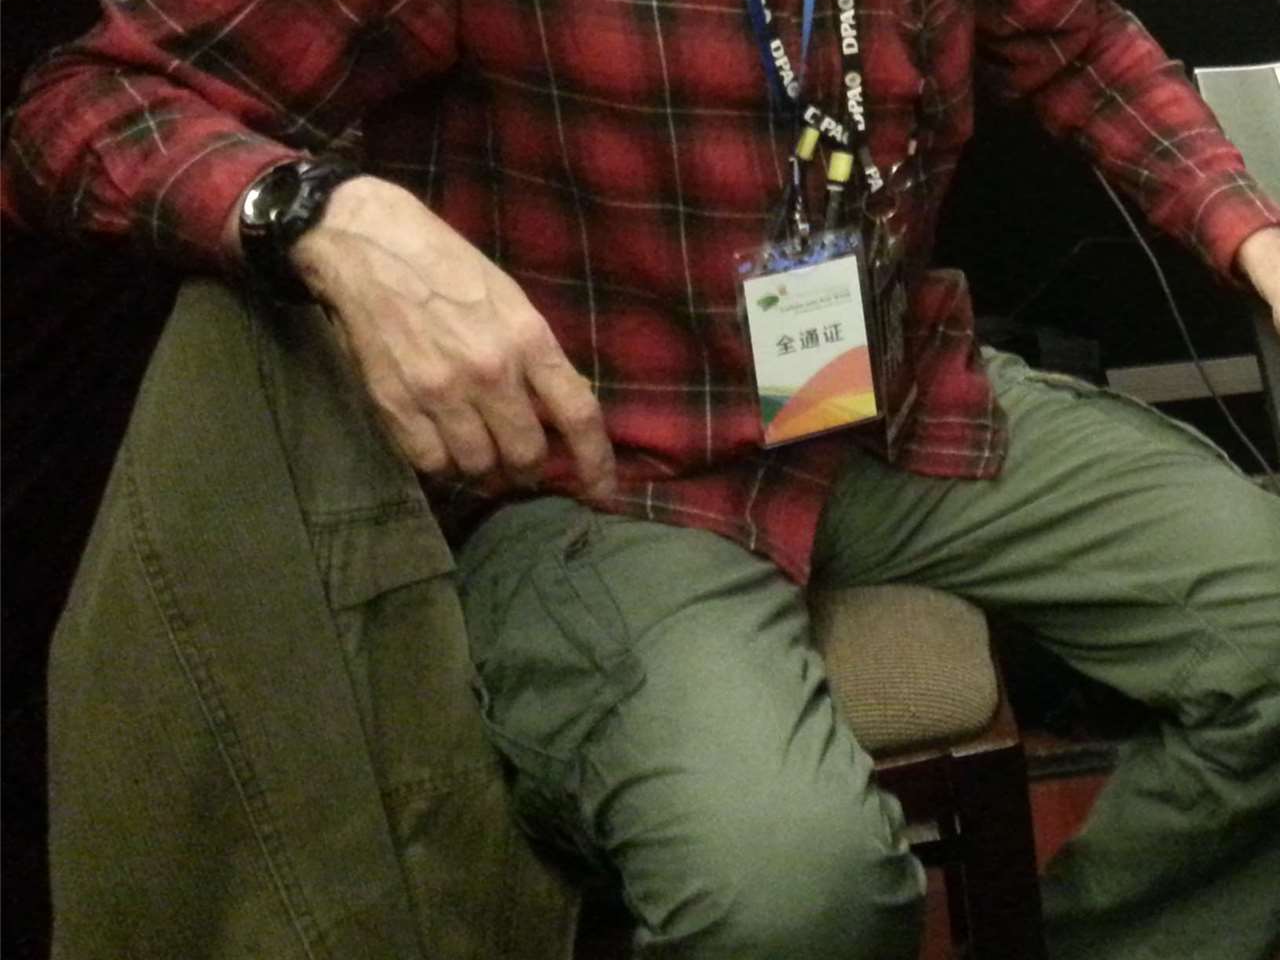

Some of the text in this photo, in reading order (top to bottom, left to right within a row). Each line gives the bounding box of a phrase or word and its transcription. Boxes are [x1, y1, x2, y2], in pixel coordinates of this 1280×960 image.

[840, 9, 859, 56] DPA
[770, 39, 795, 87] DPA
[776, 323, 845, 357] 全通证
